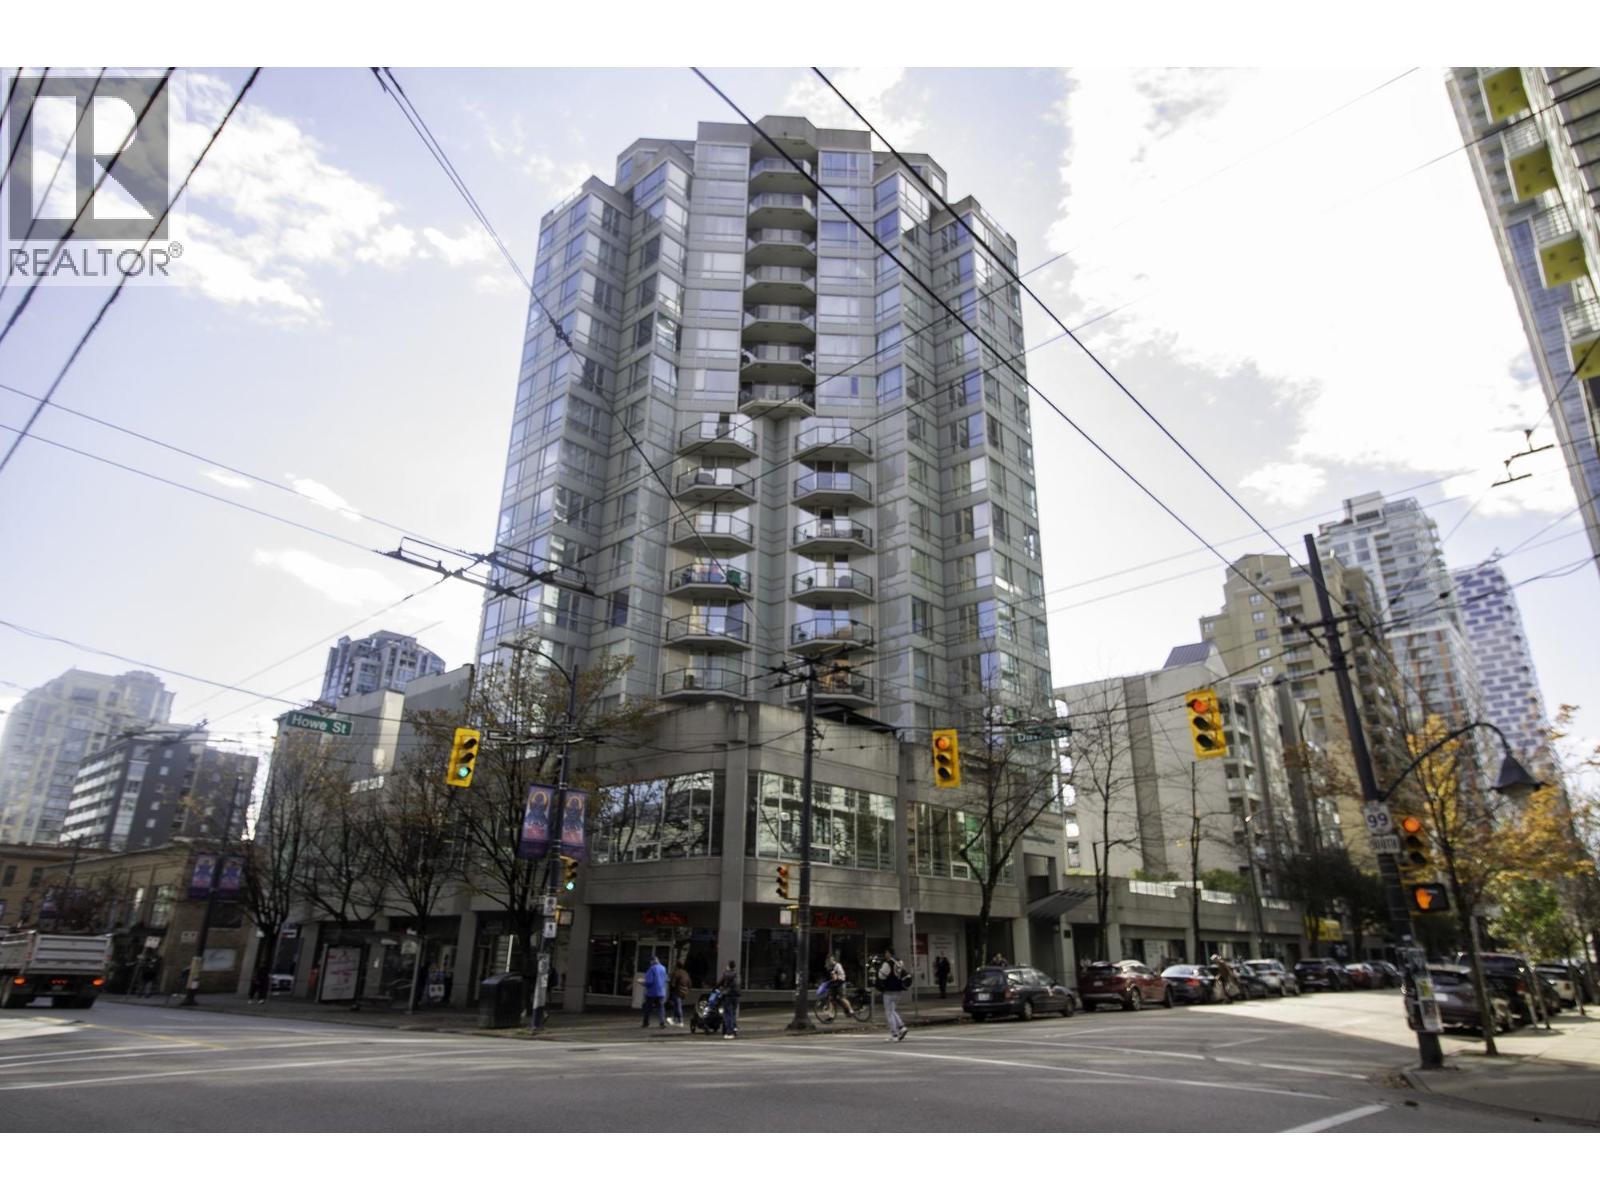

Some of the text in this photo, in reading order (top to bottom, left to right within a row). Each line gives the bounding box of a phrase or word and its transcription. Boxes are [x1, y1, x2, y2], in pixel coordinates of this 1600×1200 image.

[291, 714, 347, 734] Howe St
[1367, 812, 1388, 828] 99
